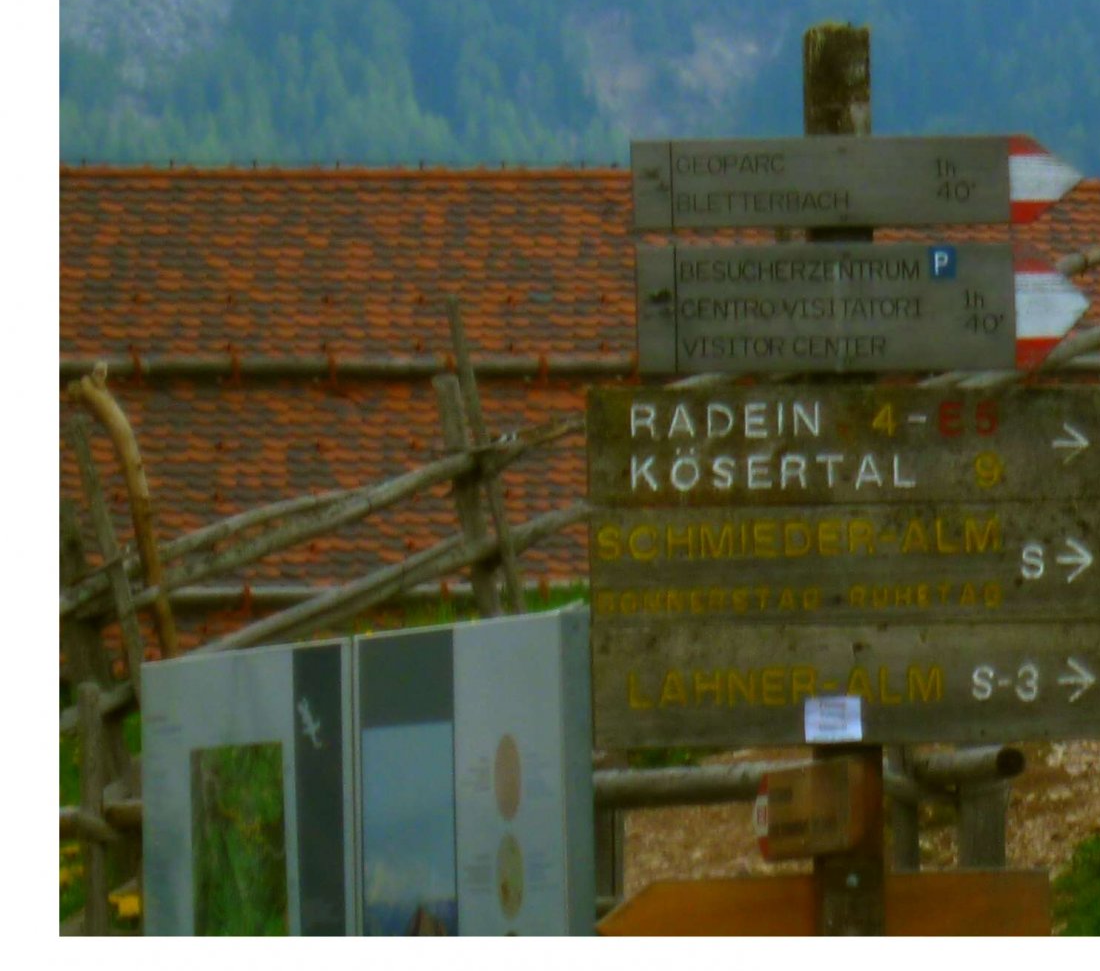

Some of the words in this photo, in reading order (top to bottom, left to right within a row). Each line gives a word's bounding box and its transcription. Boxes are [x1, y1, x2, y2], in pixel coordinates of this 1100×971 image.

[676, 152, 785, 176] GEOPARC
[676, 190, 850, 214] BLETTERBACH
[679, 260, 920, 282] BESUCHERZENTRUM
[934, 251, 949, 276] P
[680, 297, 776, 320] CENTRO
[781, 296, 922, 319] VISITATORI
[682, 336, 784, 359] VISITOR
[792, 335, 887, 358] CENTER
[630, 401, 822, 439] RADEIN
[630, 447, 917, 492] KÖSERTAL
[974, 452, 1002, 489] 9
[598, 517, 1001, 563] SCHMIEDER-ALM
[1020, 542, 1046, 581] S
[627, 665, 944, 711] LAHNER-ALM
[971, 663, 1041, 703] S-3
